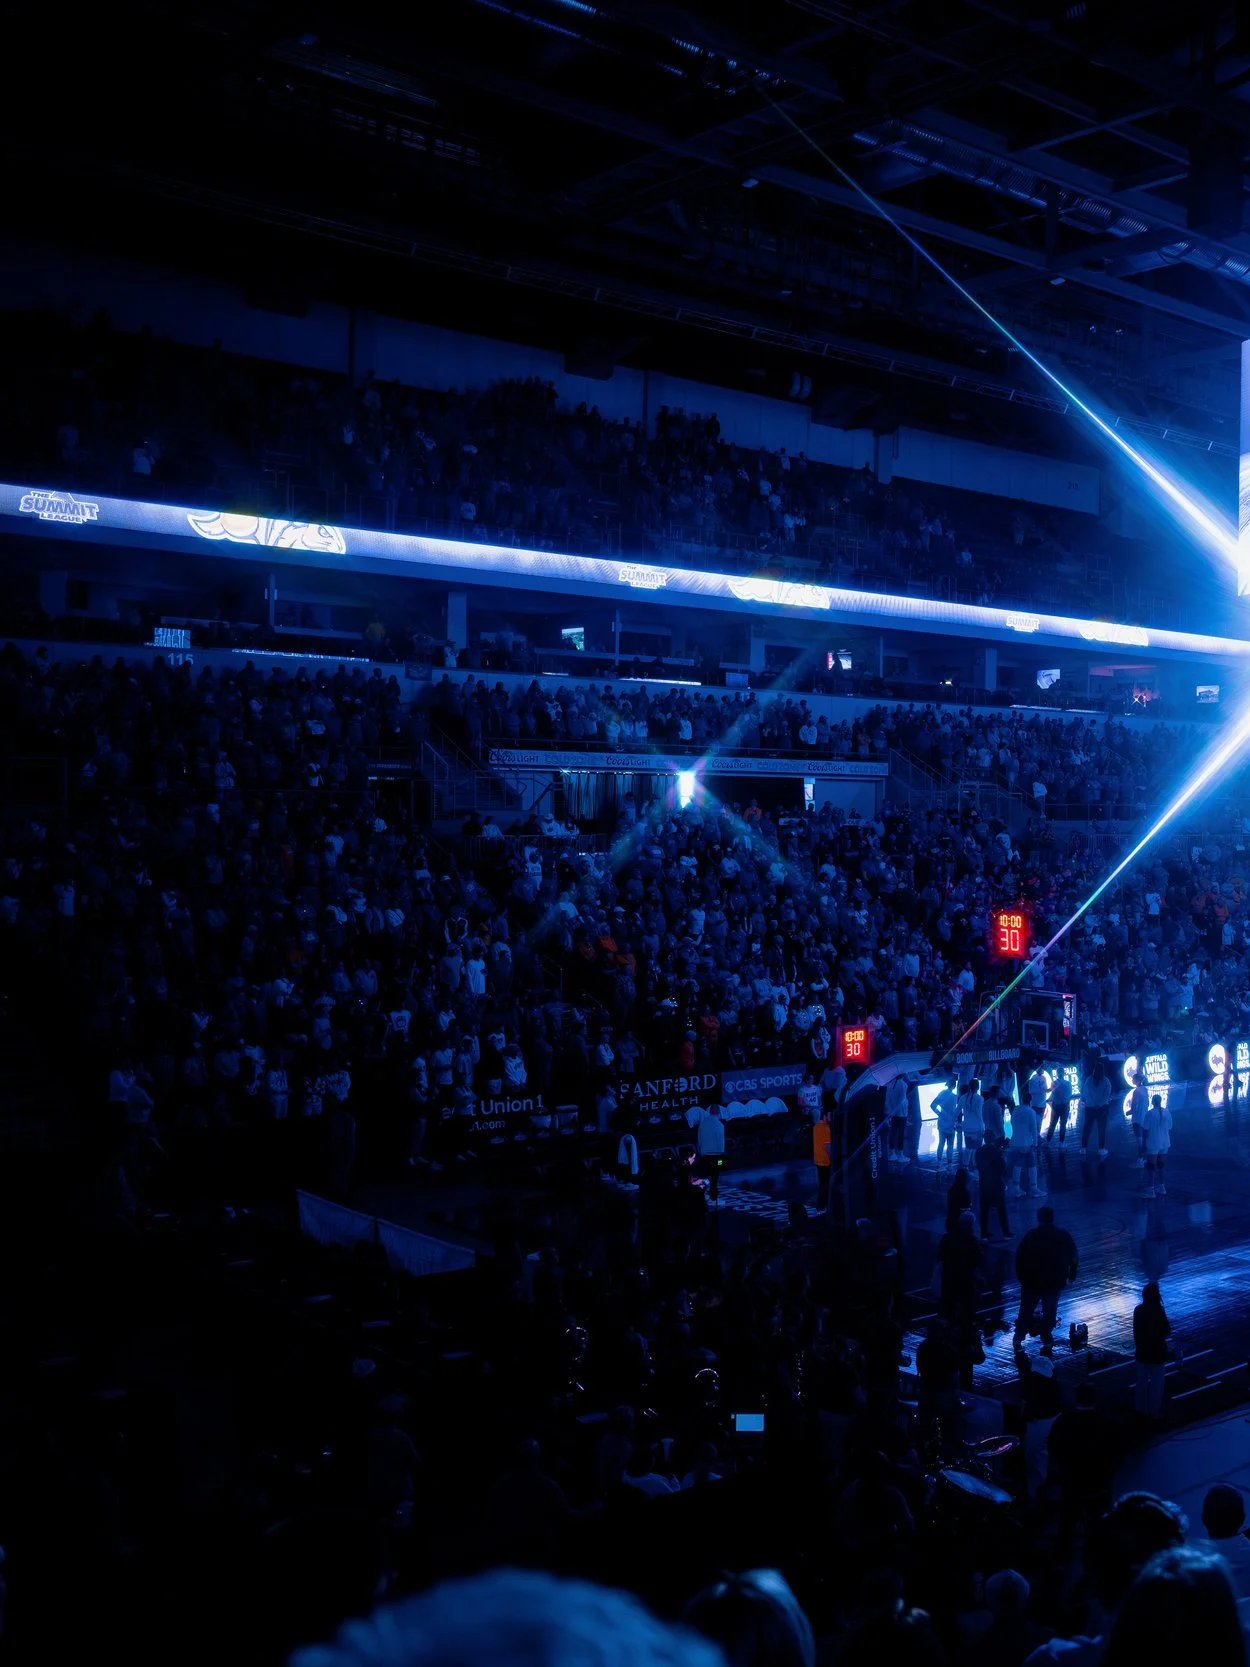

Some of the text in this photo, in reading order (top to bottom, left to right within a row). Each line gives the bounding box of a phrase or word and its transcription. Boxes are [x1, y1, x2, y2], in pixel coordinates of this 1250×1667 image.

[30, 491, 50, 499] THE
[21, 495, 98, 519] SUMMIT
[40, 512, 83, 523] LEAGUE
[620, 570, 666, 586] SUMMIT
[516, 755, 539, 763] LIGHT
[606, 757, 631, 766] Coors
[733, 760, 752, 769] LIGHT
[807, 762, 829, 772] Coors
[827, 764, 846, 772] LIGHT
[1000, 914, 1021, 928] 10:00
[1001, 929, 1019, 951] 30
[845, 1031, 864, 1041] 10:00
[847, 1043, 860, 1056] 30
[956, 1048, 1020, 1064] BOOK BILLBOARD
[1145, 1061, 1169, 1074] WILD
[619, 1074, 803, 1099] SANFORD CBS SPORTS
[640, 1096, 699, 1111] HEALTH
